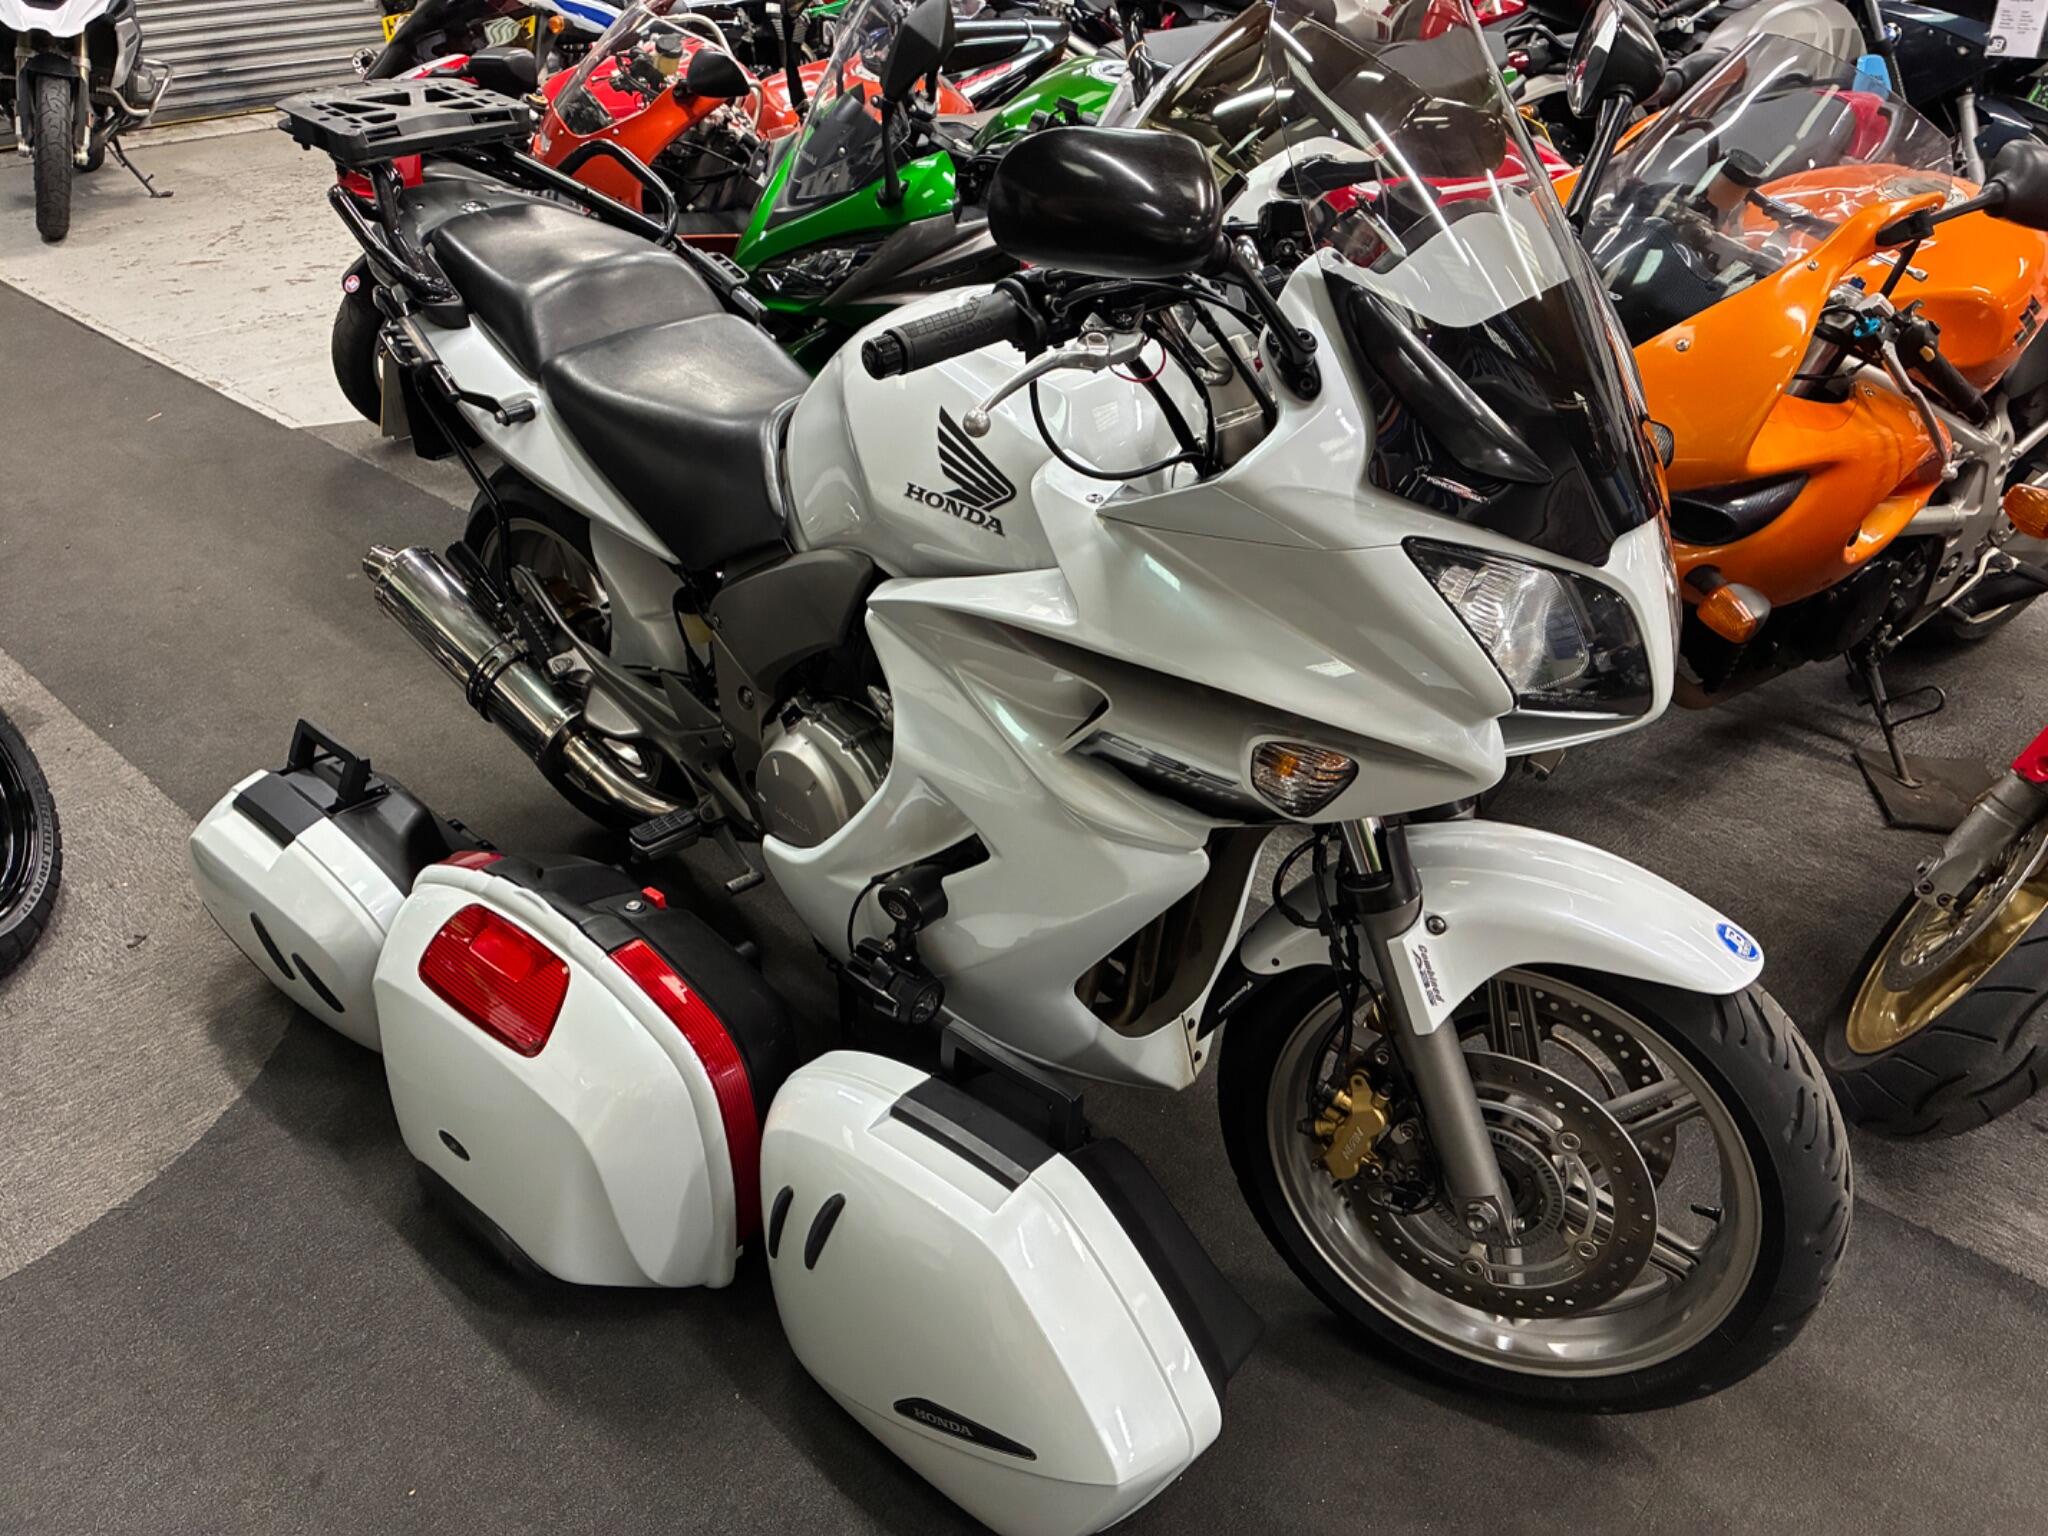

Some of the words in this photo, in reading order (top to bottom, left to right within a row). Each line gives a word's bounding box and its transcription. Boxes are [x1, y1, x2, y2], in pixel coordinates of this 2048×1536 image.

[904, 481, 1006, 538] HONDA
[33, 858, 50, 895] 120/70
[913, 1407, 975, 1438] HONDA
